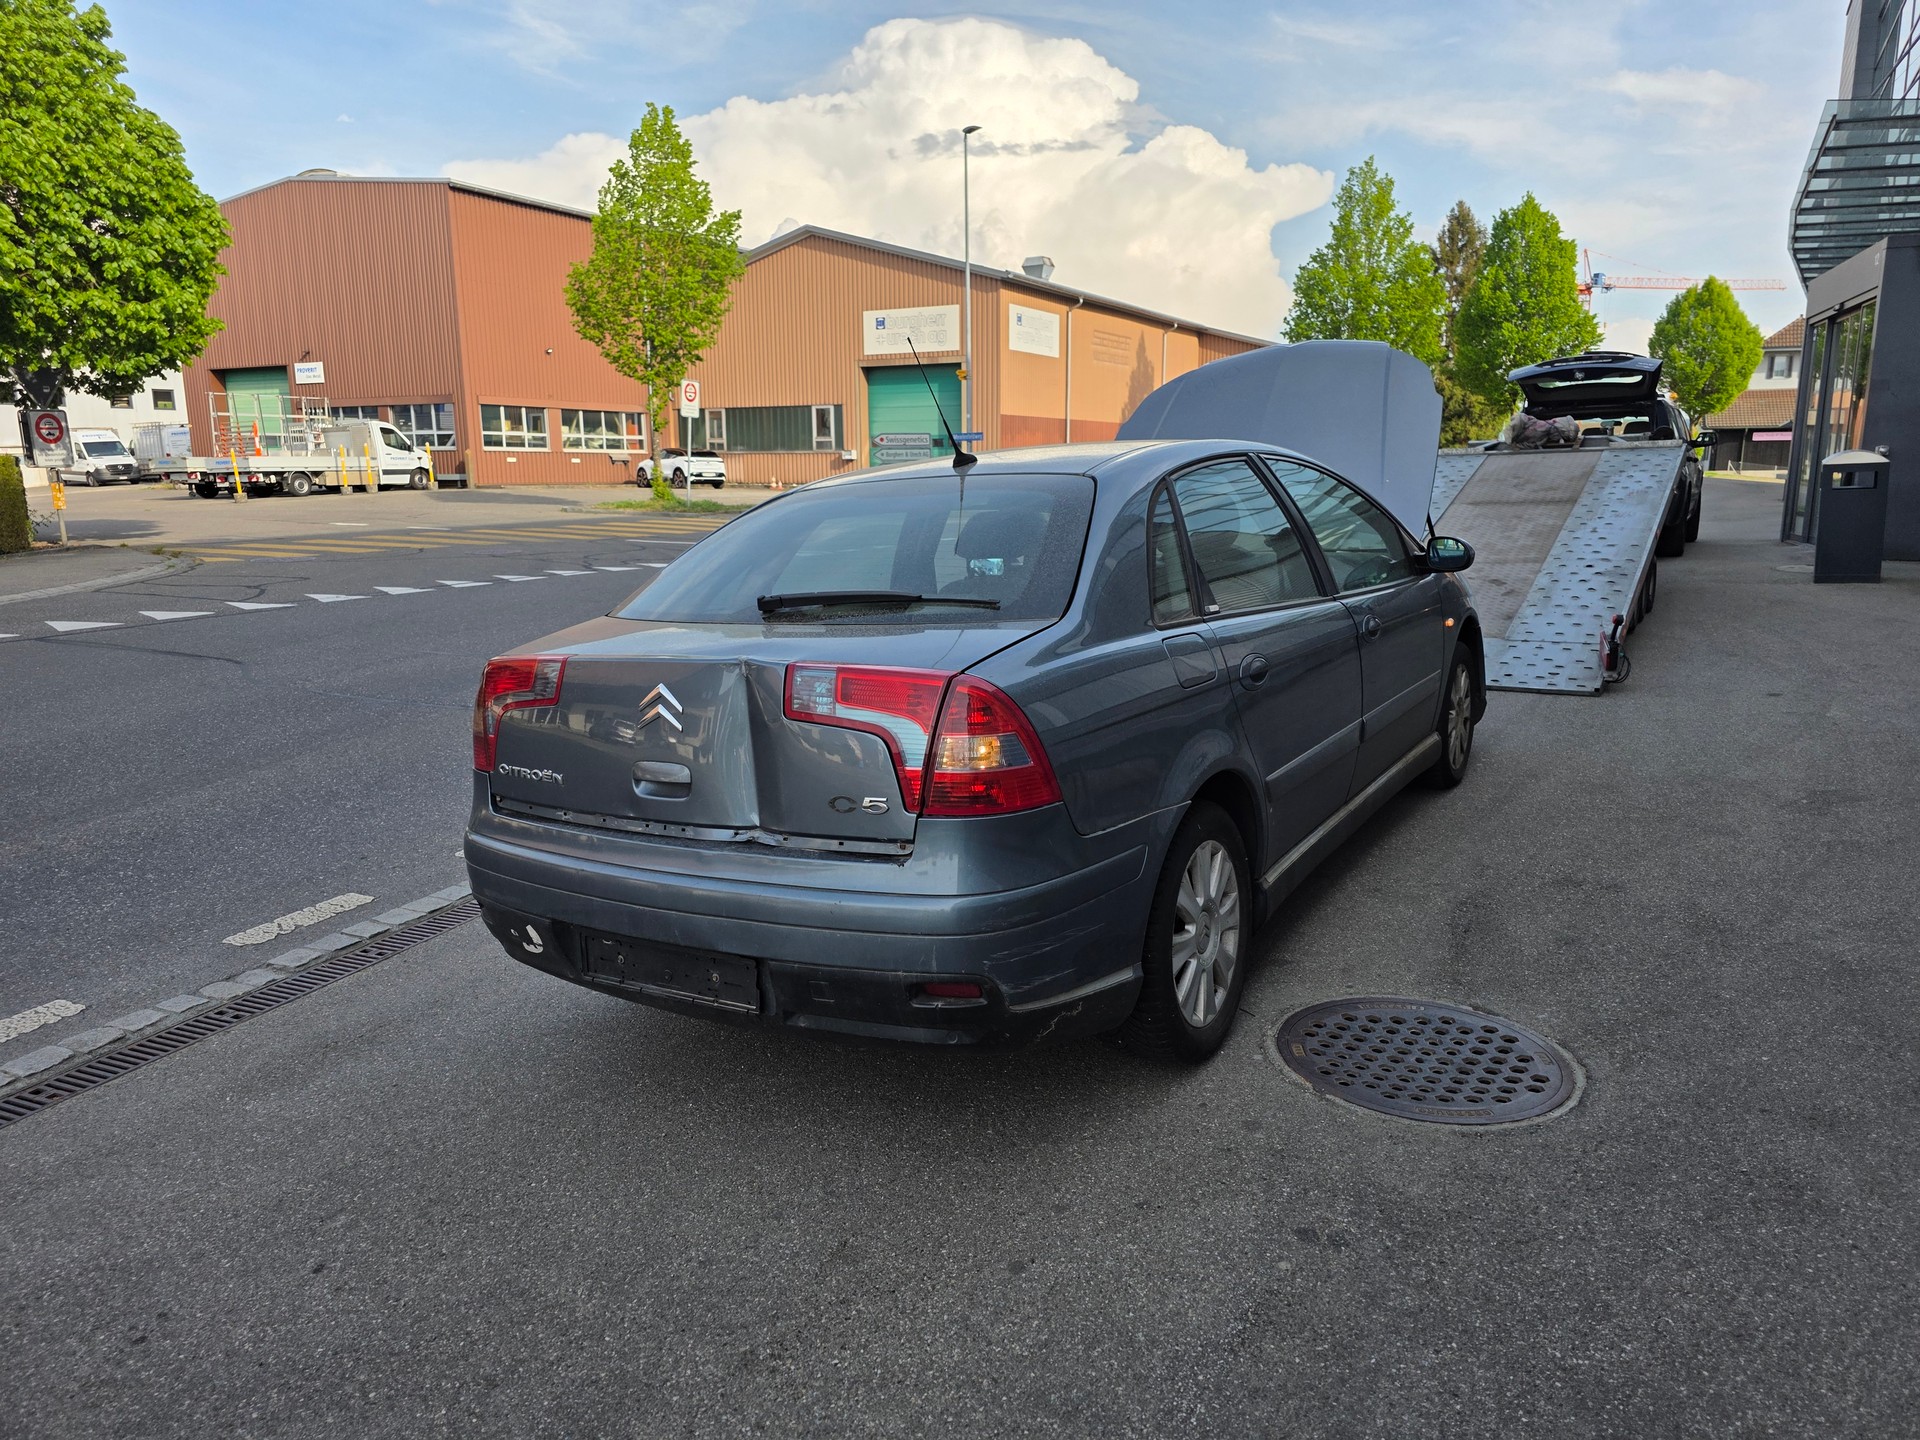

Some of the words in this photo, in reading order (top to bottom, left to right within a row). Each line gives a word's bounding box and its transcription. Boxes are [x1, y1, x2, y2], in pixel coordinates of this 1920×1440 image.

[886, 312, 947, 331] burgherr
[928, 329, 948, 347] ag
[885, 436, 928, 446] Swissgenetics
[498, 763, 565, 785] CITROËN
